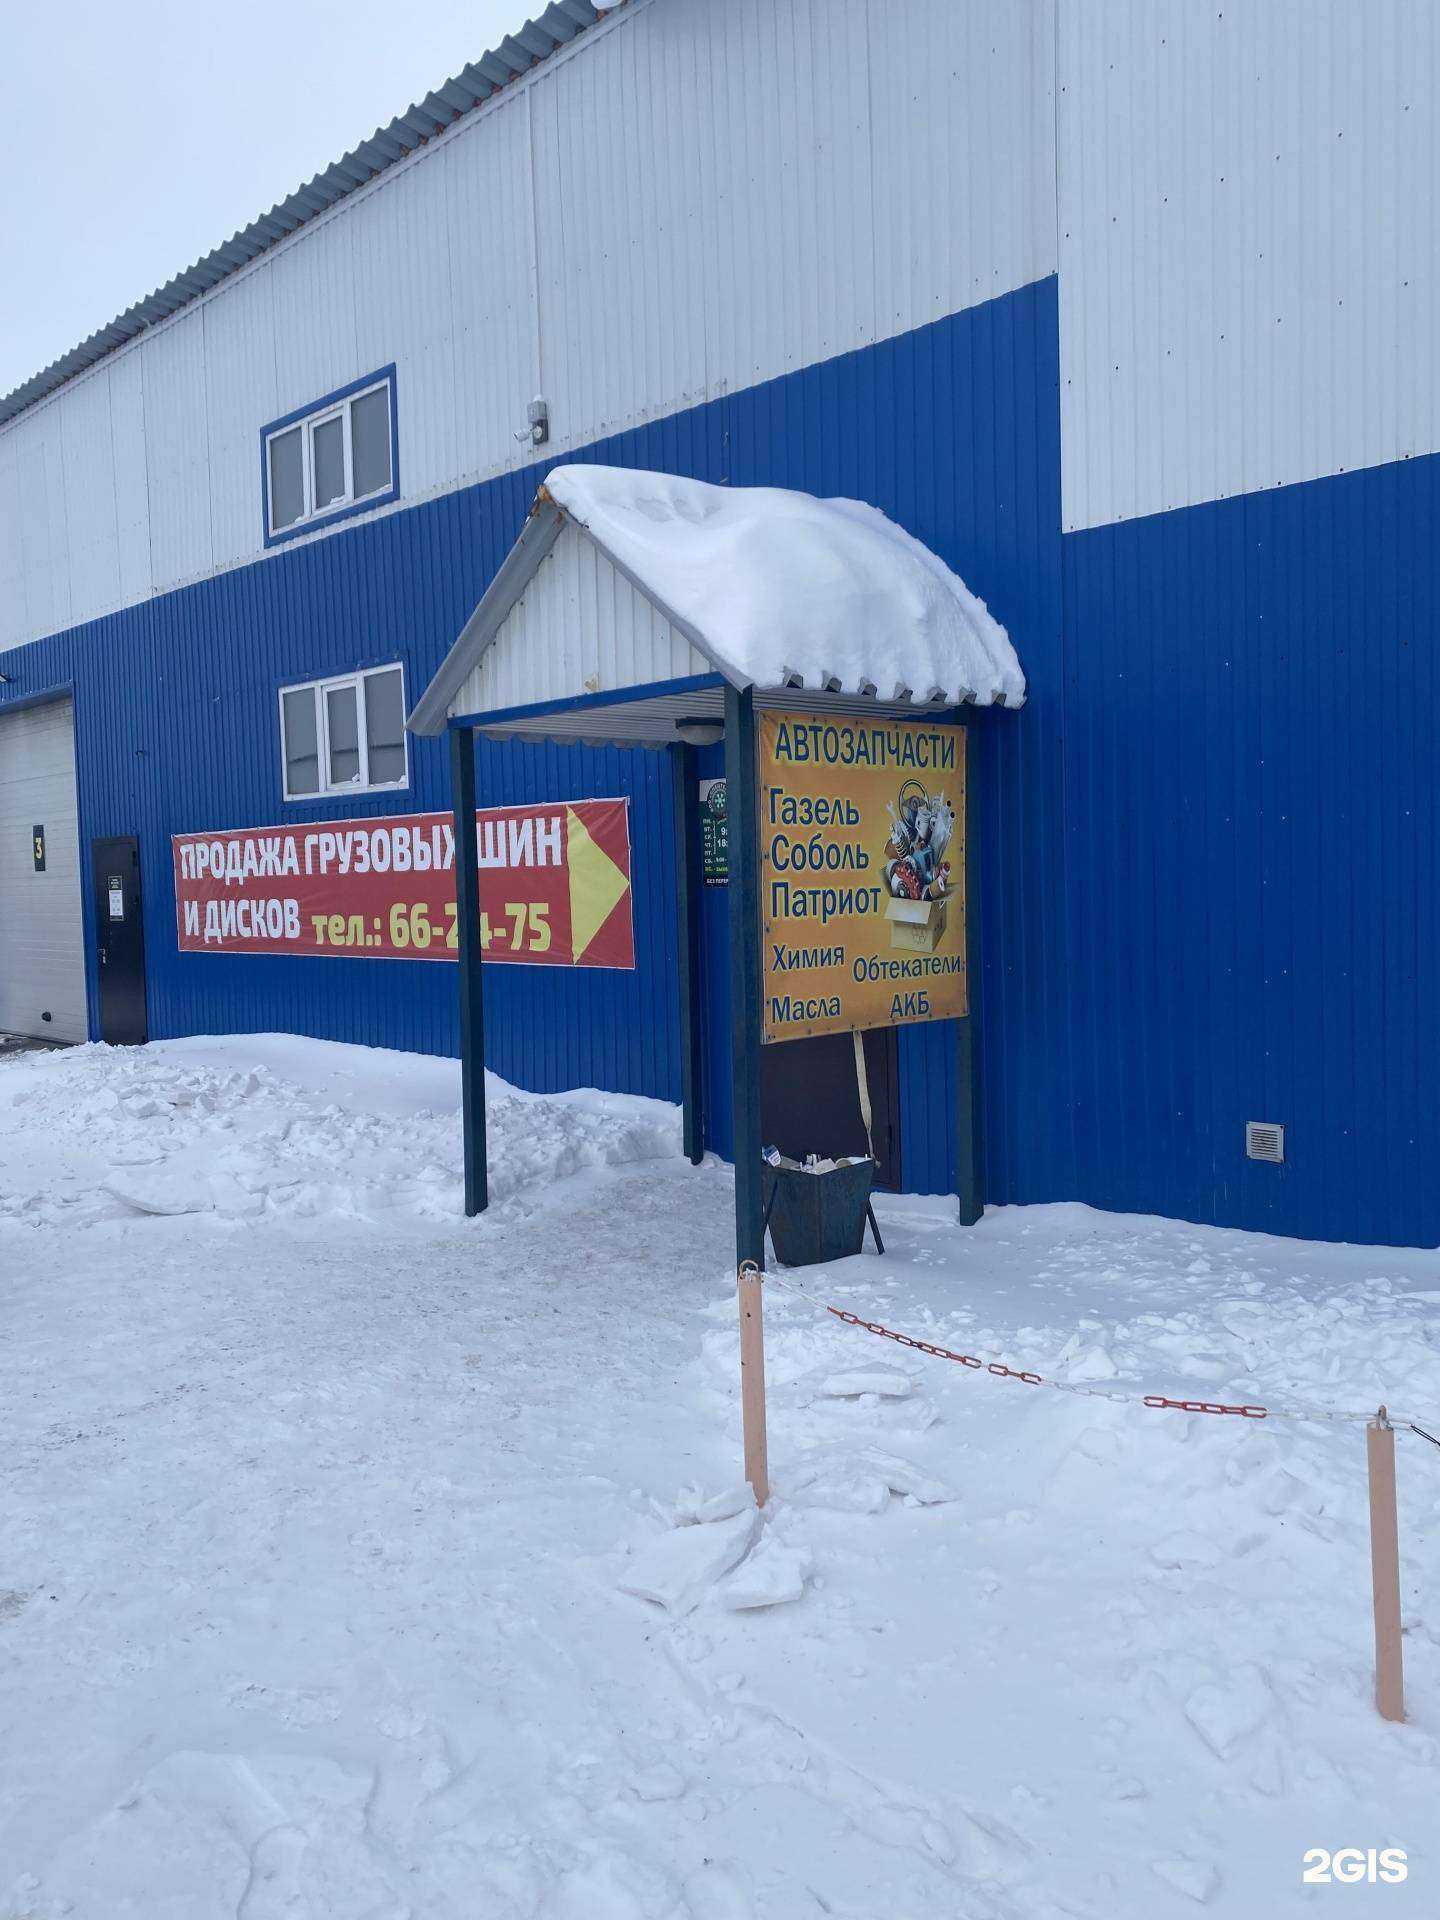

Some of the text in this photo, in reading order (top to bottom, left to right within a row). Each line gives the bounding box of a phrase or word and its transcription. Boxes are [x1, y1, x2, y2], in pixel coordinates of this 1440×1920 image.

[775, 722, 955, 769] АВТОЗАПЧАСТИ
[769, 787, 860, 826] Газель
[35, 837, 43, 859] 3
[180, 837, 296, 885] ПРОДАЖА
[477, 816, 562, 868] ШИН
[771, 832, 869, 871] Соболь
[771, 881, 881, 924] Патриот
[183, 900, 200, 936] И
[203, 898, 300, 944] ДИСКОВ
[311, 913, 382, 947] тел.:
[772, 944, 844, 972] Химия
[853, 954, 962, 983] Обтекатели
[771, 995, 841, 1024] Масла
[890, 990, 930, 1018] АКБ
